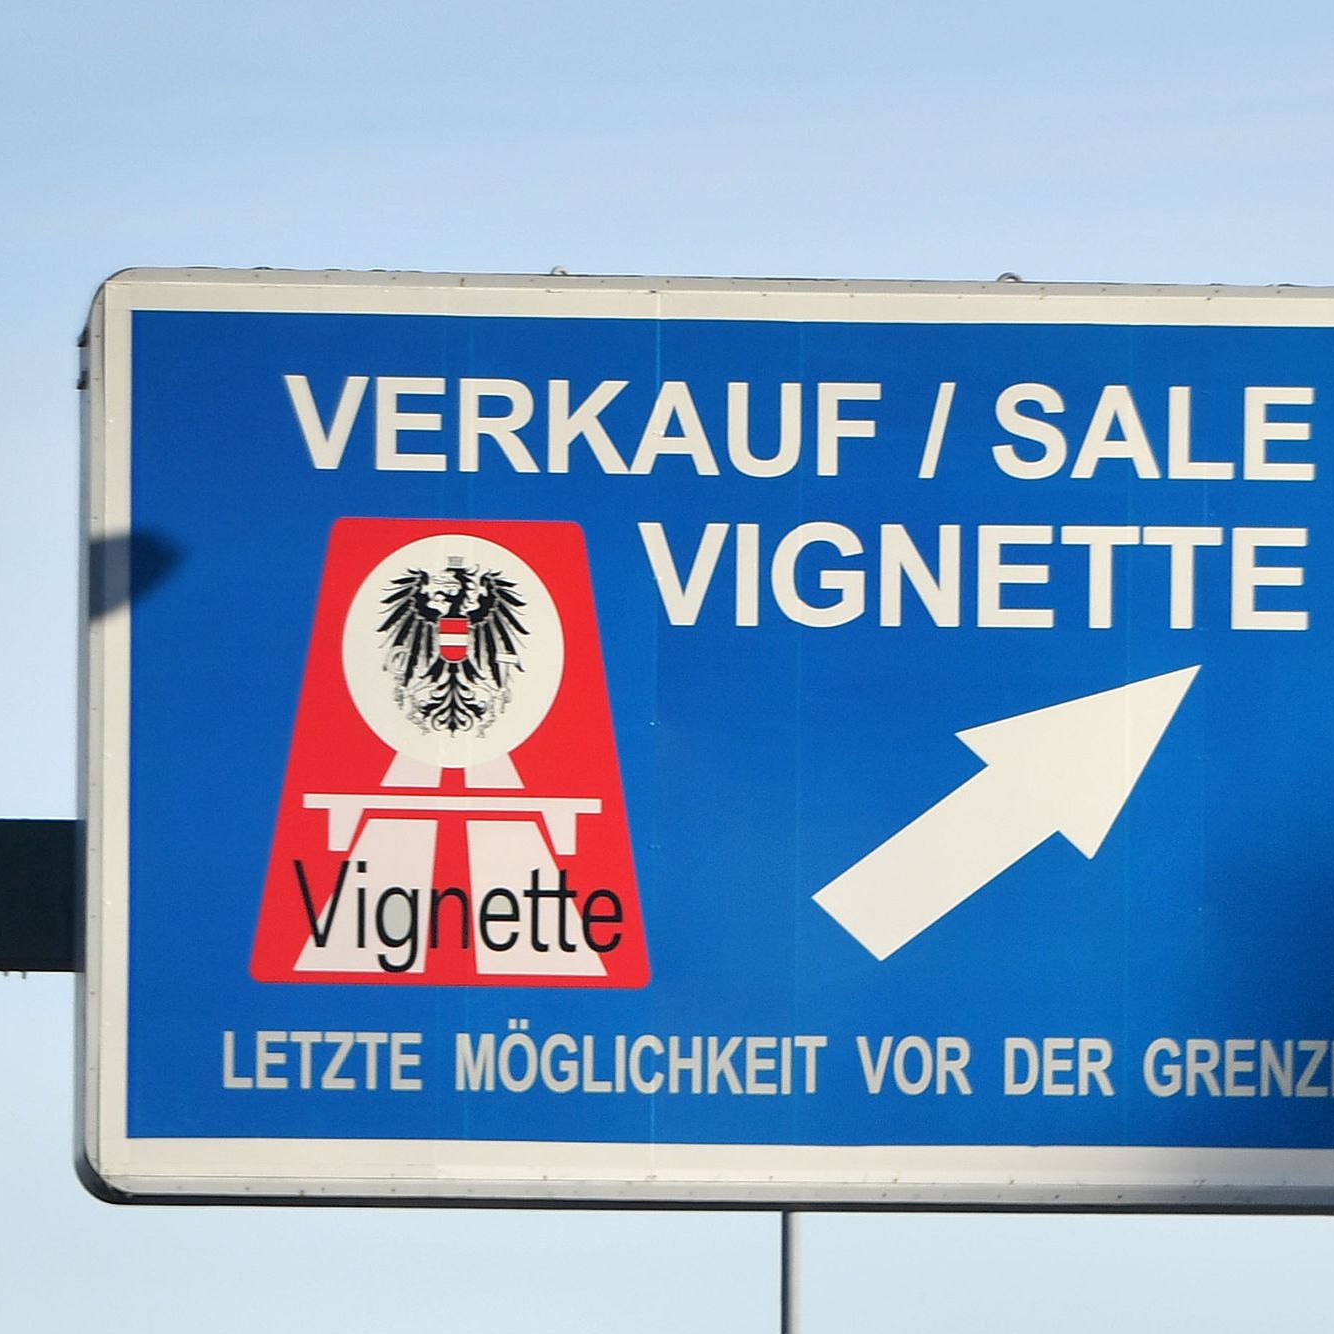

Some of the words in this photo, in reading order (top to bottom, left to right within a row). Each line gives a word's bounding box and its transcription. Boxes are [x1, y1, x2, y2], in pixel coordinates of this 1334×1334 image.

[282, 374, 885, 478] VERKAUF
[919, 382, 956, 479] /
[994, 380, 1316, 482] SALE
[639, 521, 1310, 632] VIGNETTE
[296, 858, 624, 974] Vignette
[222, 1030, 422, 1092] LETZTE
[455, 1020, 827, 1096] MÖGLICHKEIT
[856, 1035, 972, 1096] VOR
[1004, 1037, 1113, 1097] DER
